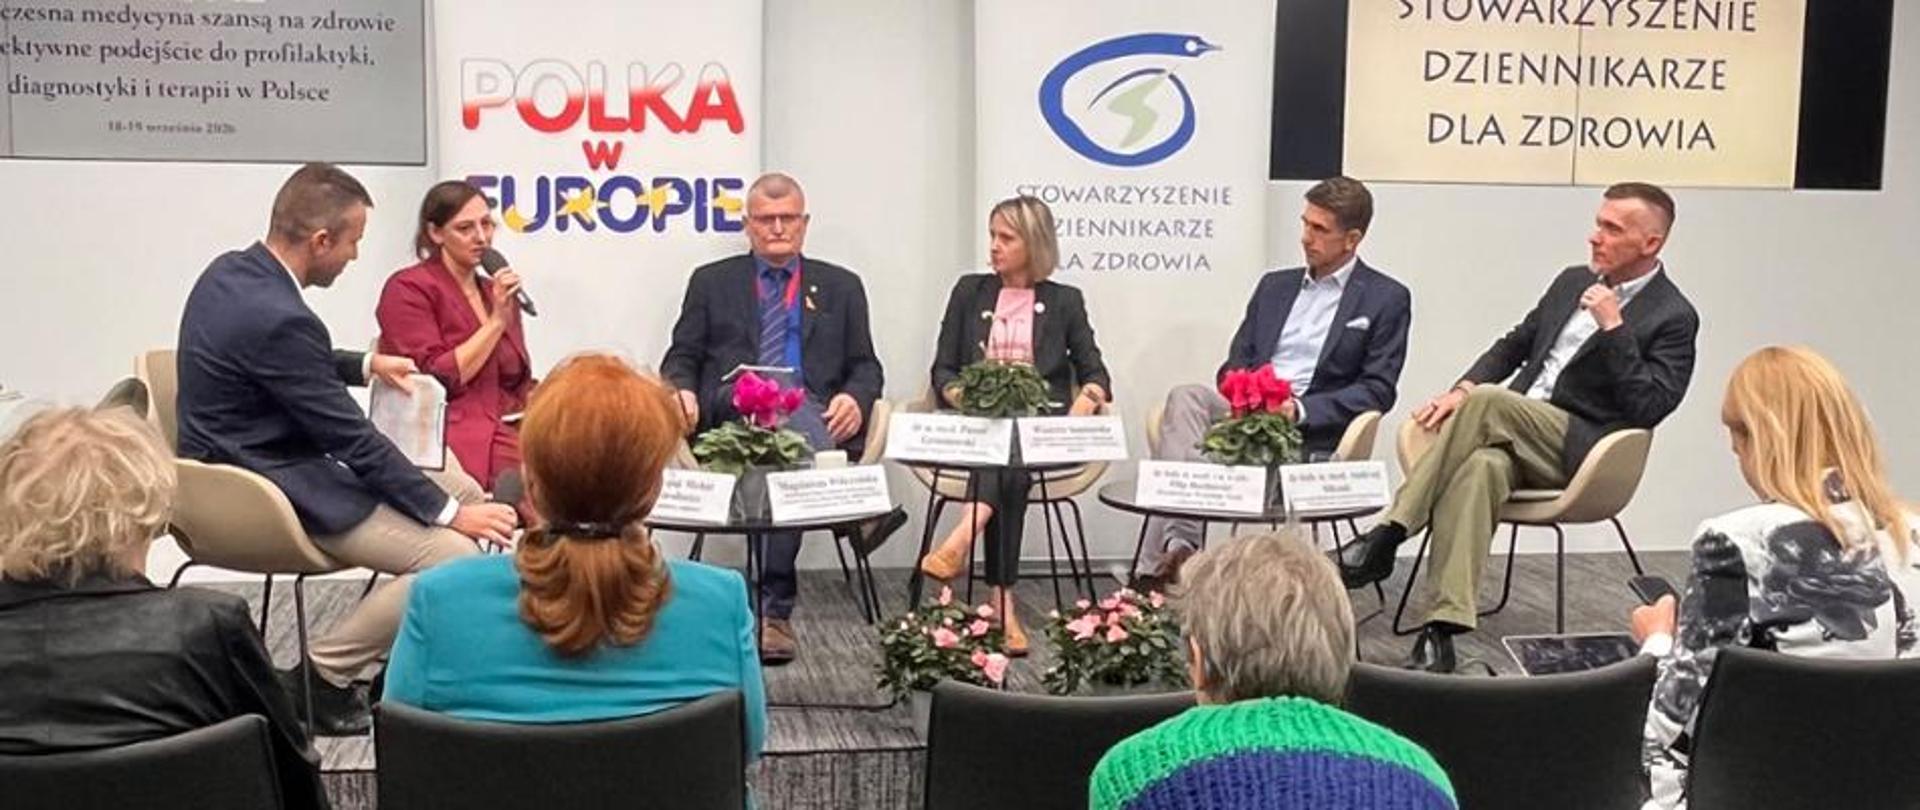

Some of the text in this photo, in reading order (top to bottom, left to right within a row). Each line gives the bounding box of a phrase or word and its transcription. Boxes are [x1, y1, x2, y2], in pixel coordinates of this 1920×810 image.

[0, 4, 396, 34] czesna medycyna szansą na zdrowie
[1399, 0, 1757, 32] STOWARZYSZENIE
[0, 35, 92, 63] ektywne
[100, 38, 202, 65] podejście
[210, 41, 238, 63] do
[1424, 50, 1727, 91] DZIENNIKARZE
[7, 76, 330, 104] diagnostyki i terapii w Polsce
[461, 58, 744, 134] POLKA
[1428, 112, 1716, 150] DLA ZDROWIA
[1016, 185, 1232, 206] STOWARZYSZENIE
[1055, 218, 1214, 239] ZIENNIKARZE
[1092, 252, 1212, 271] ZDROWIA
